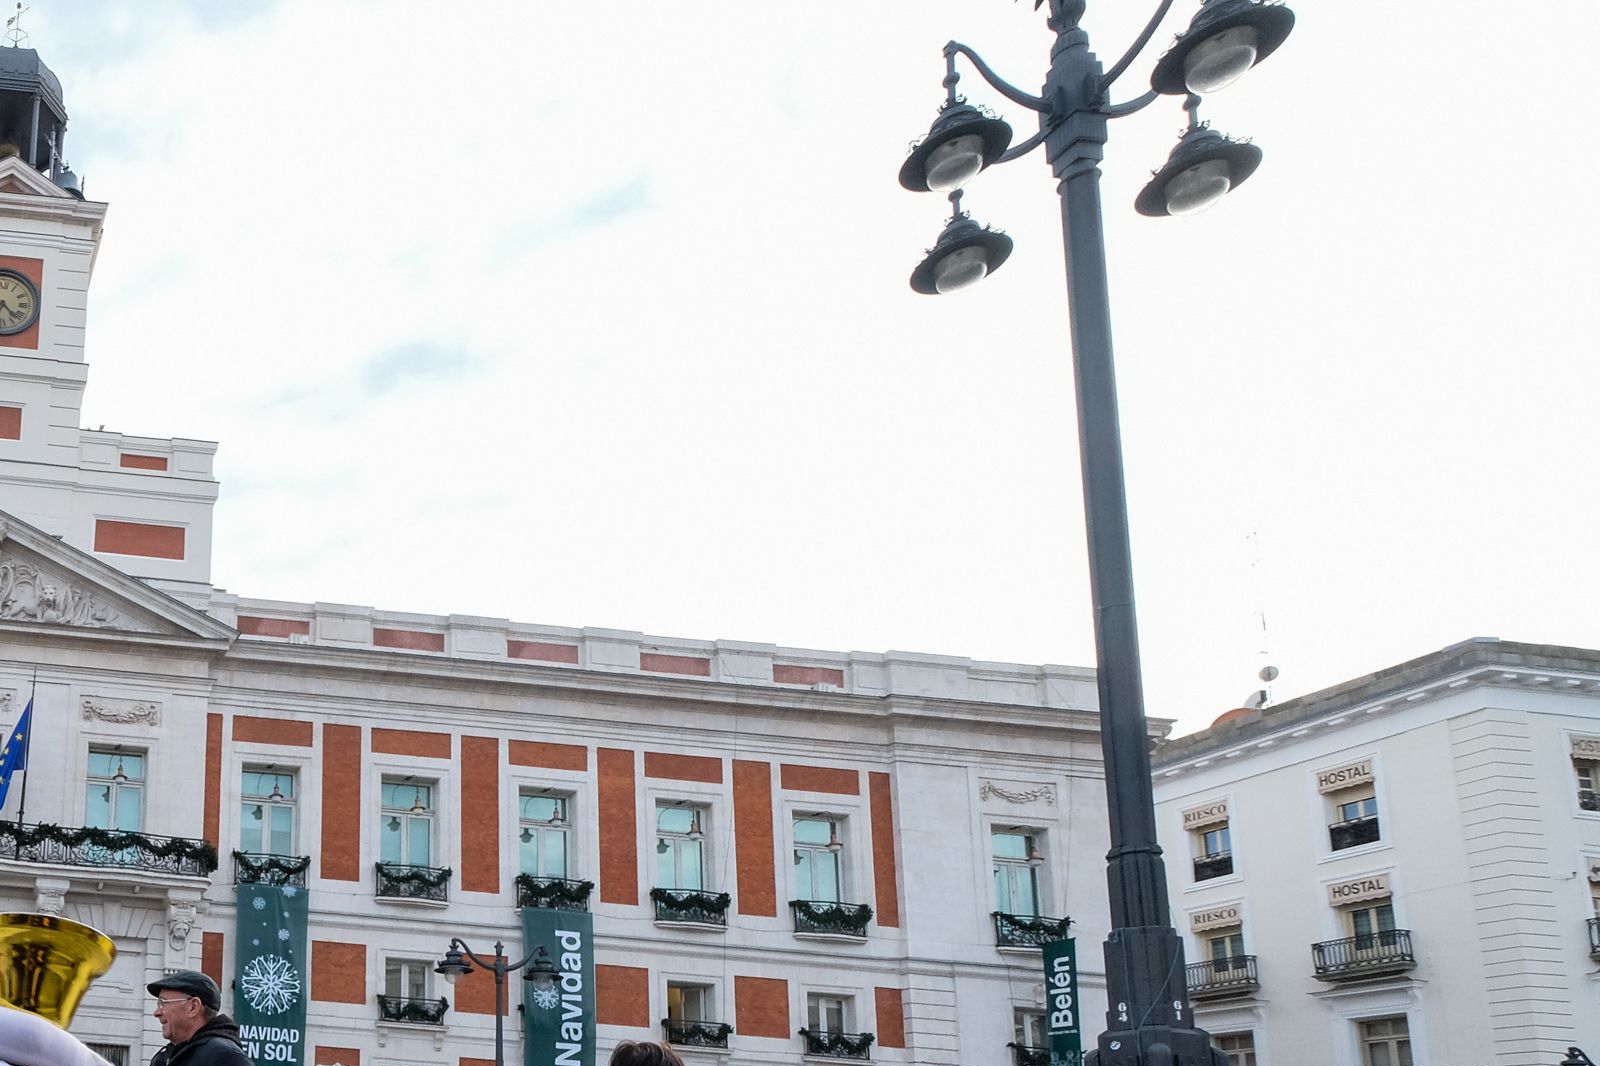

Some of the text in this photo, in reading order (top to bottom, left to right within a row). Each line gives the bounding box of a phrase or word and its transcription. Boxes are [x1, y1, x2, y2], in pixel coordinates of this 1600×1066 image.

[1319, 765, 1370, 787] HOSTAL
[1184, 804, 1227, 824] RIESCO
[1332, 879, 1385, 899] HOSTAL
[1193, 908, 1237, 925] RIESCO
[1048, 956, 1073, 1028] Belén
[239, 1024, 300, 1043] NAVIDAD
[264, 1043, 297, 1062] SOL
